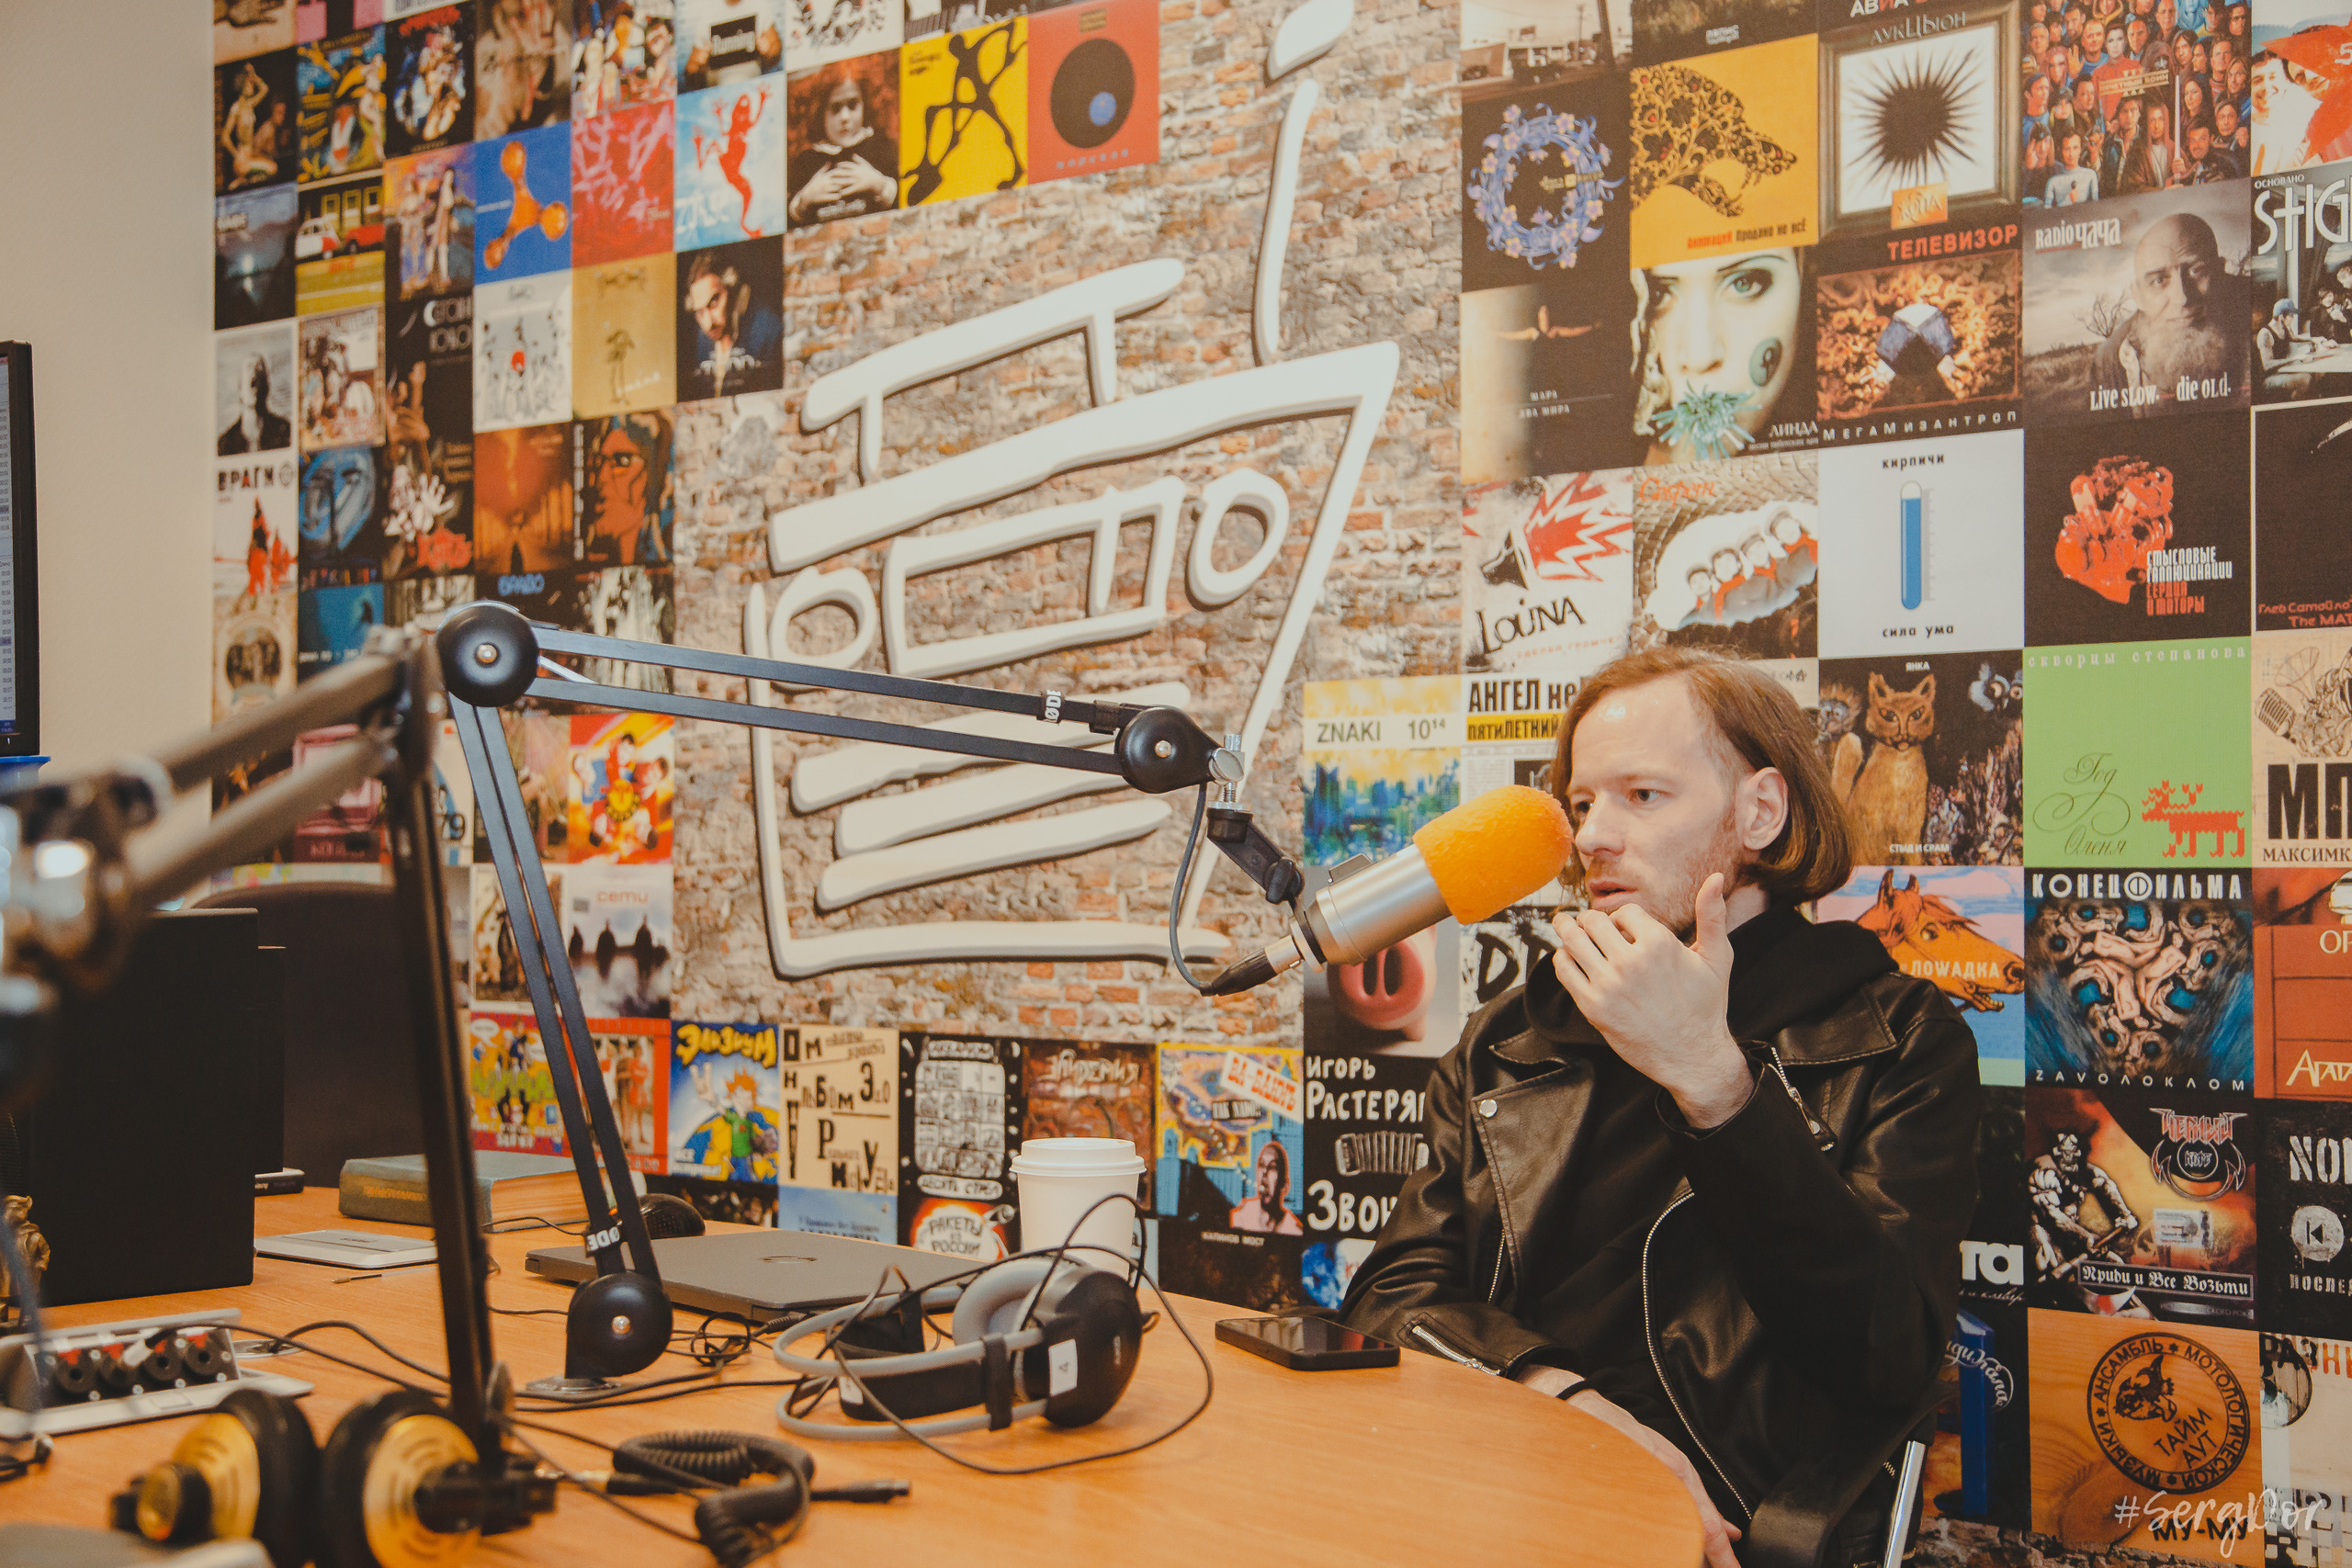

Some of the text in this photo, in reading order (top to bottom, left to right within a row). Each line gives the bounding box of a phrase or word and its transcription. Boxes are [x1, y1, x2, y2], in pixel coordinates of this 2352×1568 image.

[2255, 174, 2305, 190] ОСНОВАНО
[2254, 178, 2352, 255] STIG
[1887, 224, 2018, 262] ТЕЛЕВИЗОР
[1883, 454, 1945, 471] кирпичи
[2147, 546, 2217, 568] СМЫСЛОВЫЕ
[1882, 625, 1954, 639] сила ума
[2132, 647, 2245, 662] степанова
[1468, 678, 1541, 713] АНГЕЛ
[1317, 720, 1382, 742] ZNAKI
[1889, 843, 1915, 853] СТЫД
[1924, 843, 1950, 852] СРАМ
[2263, 847, 2352, 863] МАКСИМК
[1306, 1055, 1376, 1080] ИГОРЬ
[2286, 1049, 2352, 1087] АГАТ
[2094, 1338, 2165, 1403] АНСАМБЛЬ
[2154, 1408, 2212, 1457] ТАЙМ
[2182, 1429, 2217, 1469] АУТ
